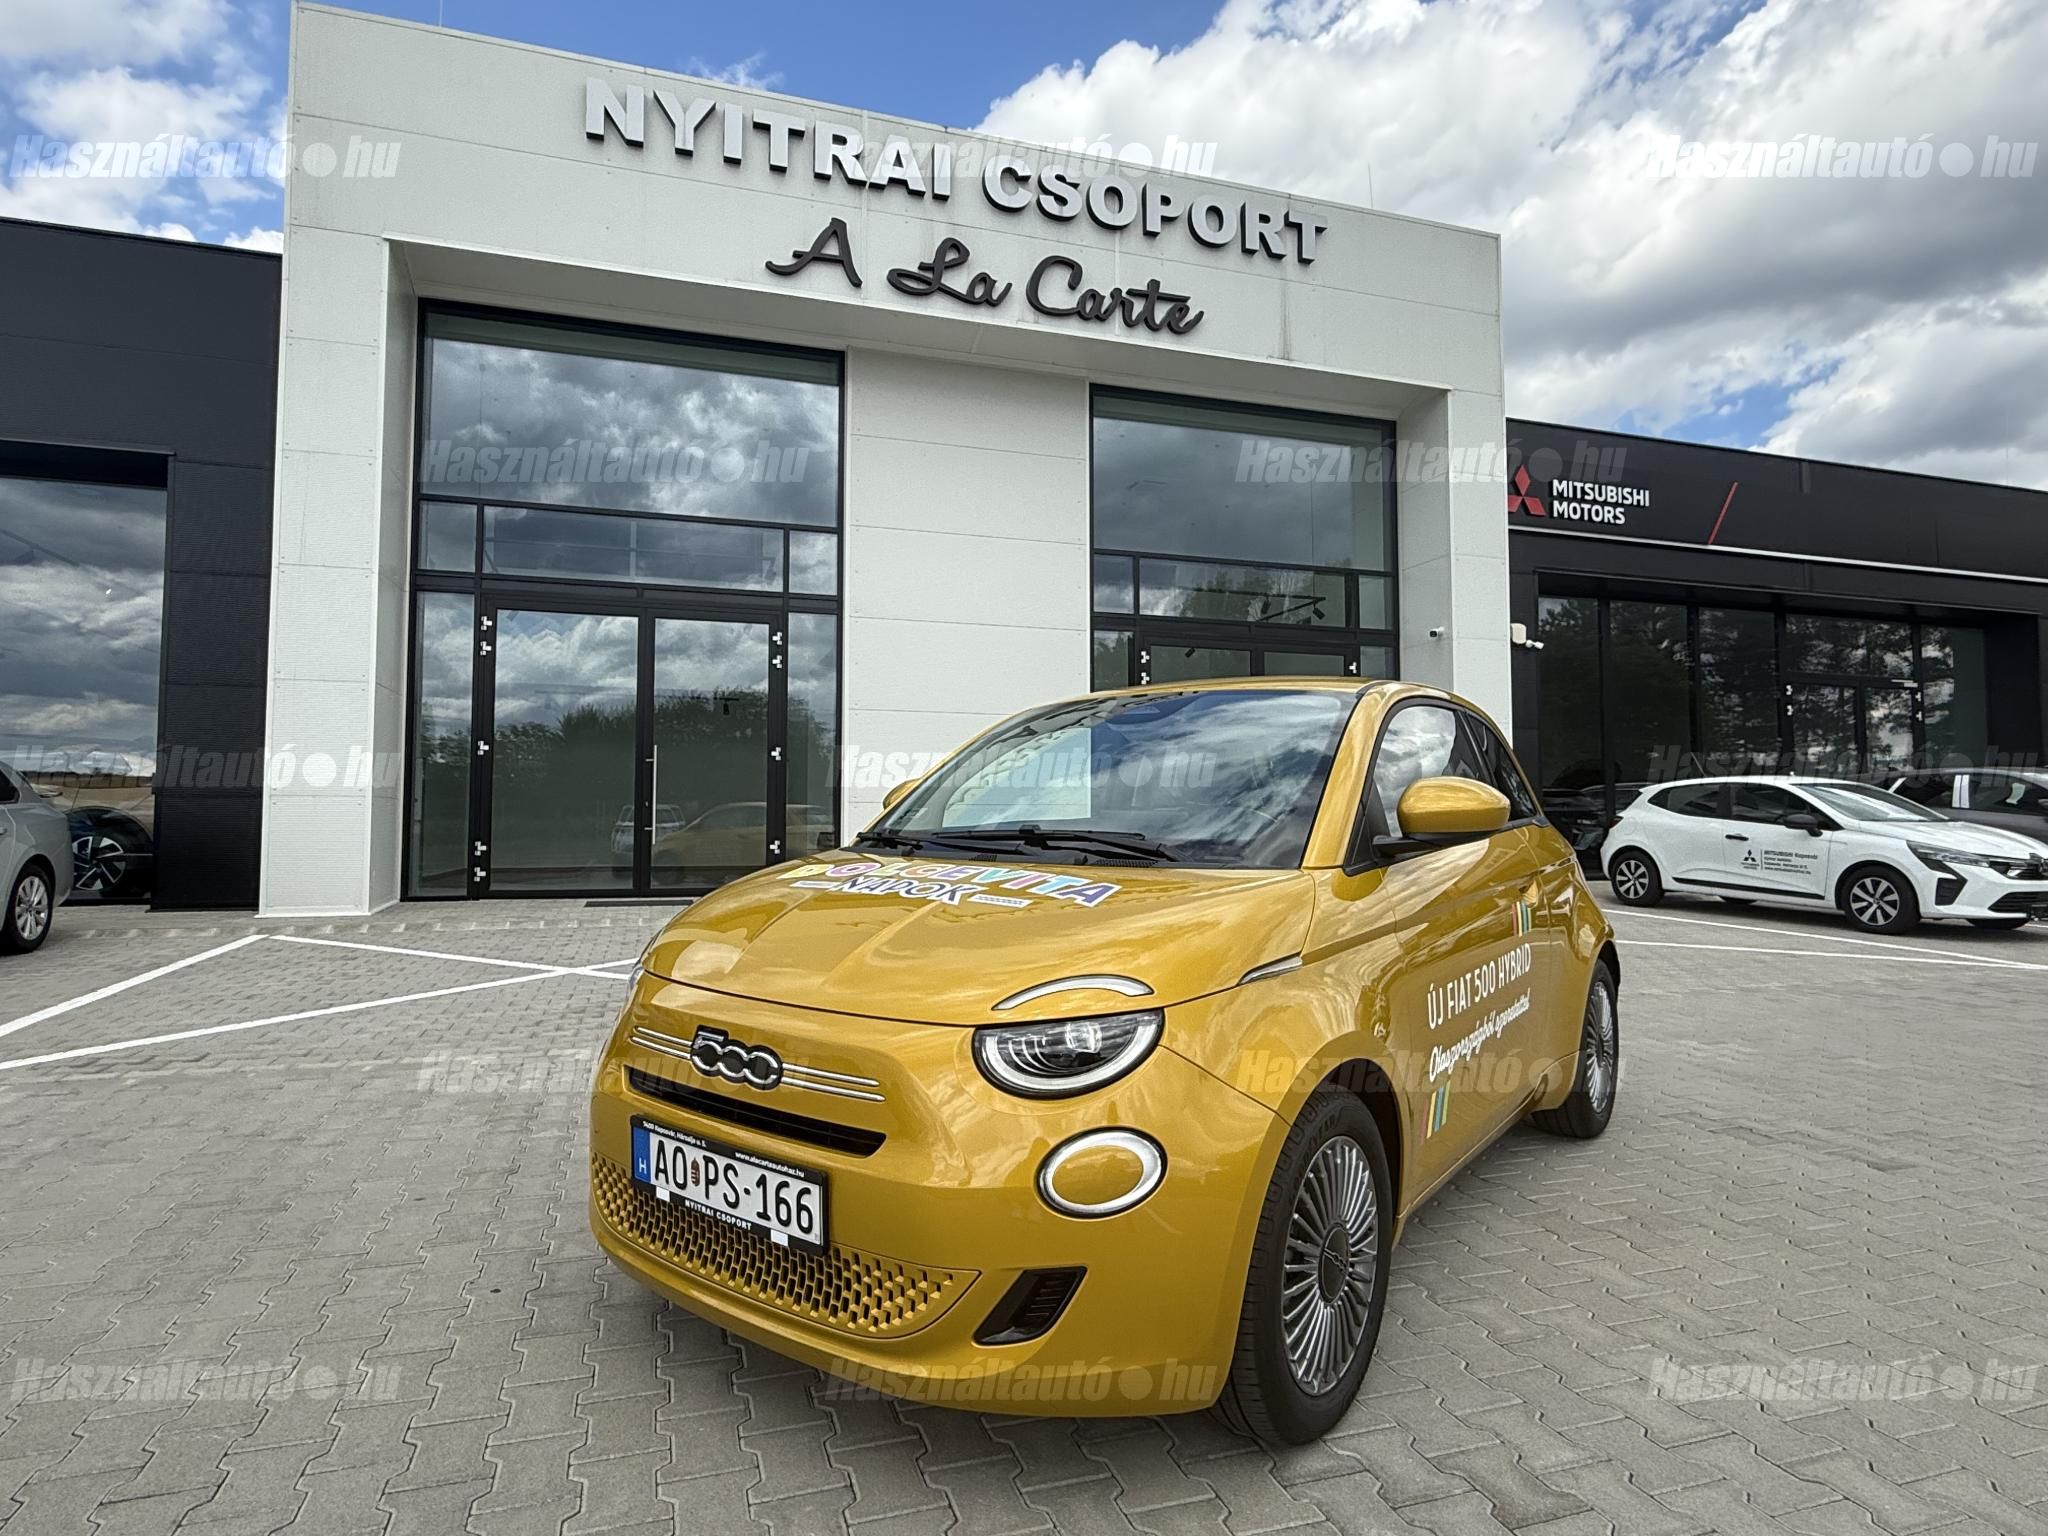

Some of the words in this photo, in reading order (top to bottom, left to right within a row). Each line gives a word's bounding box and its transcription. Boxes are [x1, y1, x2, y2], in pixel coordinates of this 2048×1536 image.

[585, 76, 952, 200] NYITRAI
[984, 155, 1328, 264] CSOPORT
[765, 217, 862, 287] A
[886, 237, 1012, 307] La
[1025, 255, 1204, 335] Carte
[1552, 478, 1650, 507] MITSUBISHI
[1552, 501, 1626, 525] MOTORS
[830, 876, 989, 905] NAPOK
[1427, 983, 1444, 1030] ÚJ
[1447, 973, 1472, 1019] FIAT
[1474, 960, 1496, 1003] 500
[1498, 943, 1531, 989] HYBRID
[691, 1024, 784, 1091] 500
[637, 1157, 648, 1175] H
[685, 1199, 714, 1217] NYITRAI
[716, 1211, 752, 1231] CSOPORT
[702, 1154, 814, 1235] PS-166
